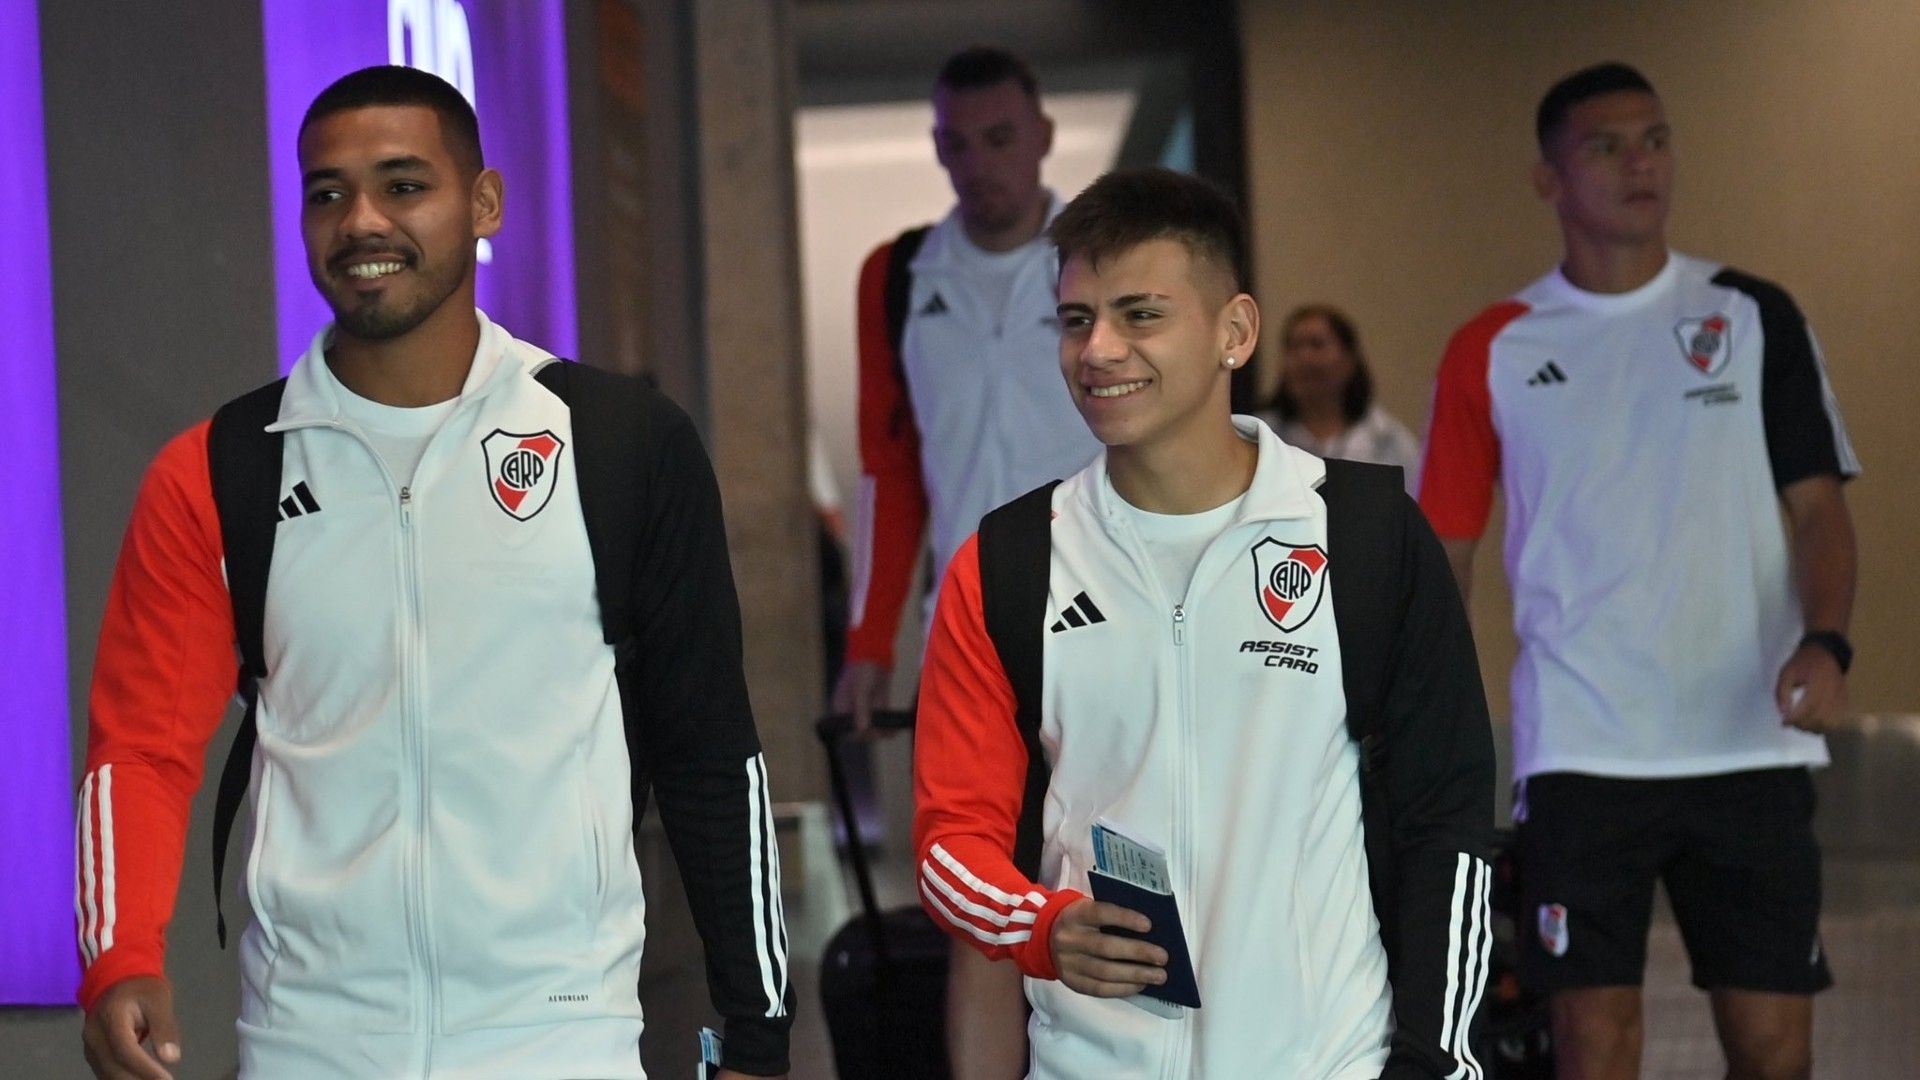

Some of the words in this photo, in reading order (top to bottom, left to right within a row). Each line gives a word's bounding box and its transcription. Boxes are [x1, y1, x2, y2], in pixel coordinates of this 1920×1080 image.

[501, 450, 544, 489] CARP
[1270, 560, 1311, 600] CARP
[1239, 641, 1318, 658] ASSIST
[1264, 655, 1318, 674] CARD
